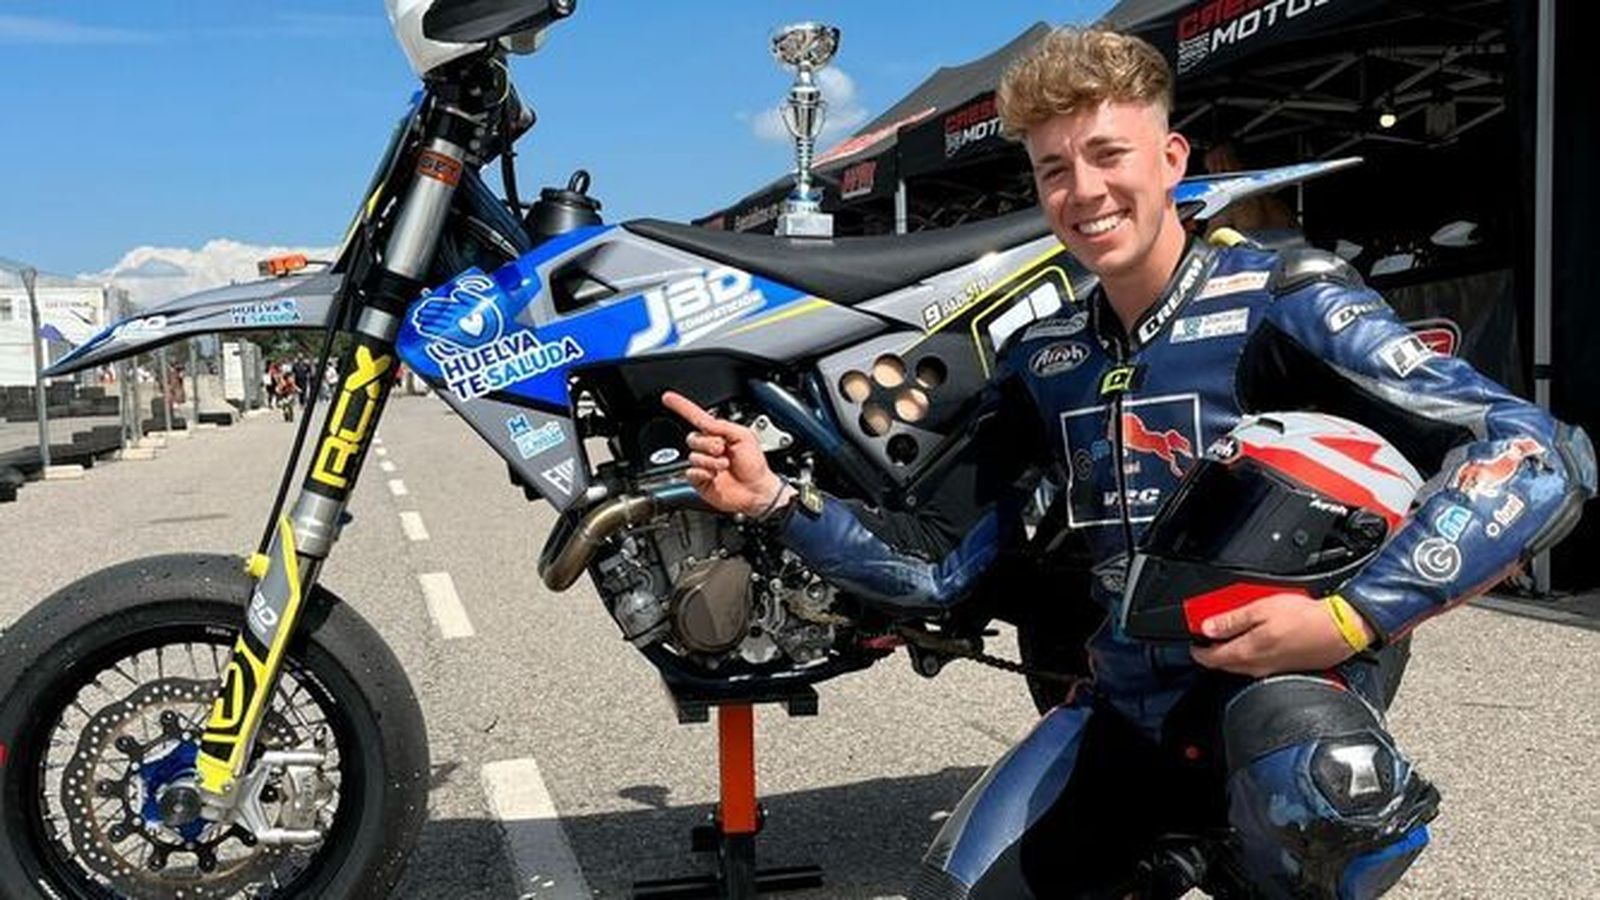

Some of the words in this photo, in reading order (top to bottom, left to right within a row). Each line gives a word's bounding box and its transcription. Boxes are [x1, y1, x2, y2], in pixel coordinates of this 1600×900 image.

[231, 304, 280, 317] HUELVA
[250, 311, 300, 324] SALUDA
[625, 266, 753, 356] JBD
[443, 332, 539, 380] HUELVA
[452, 380, 487, 402] TE
[486, 339, 582, 391] SALUDA
